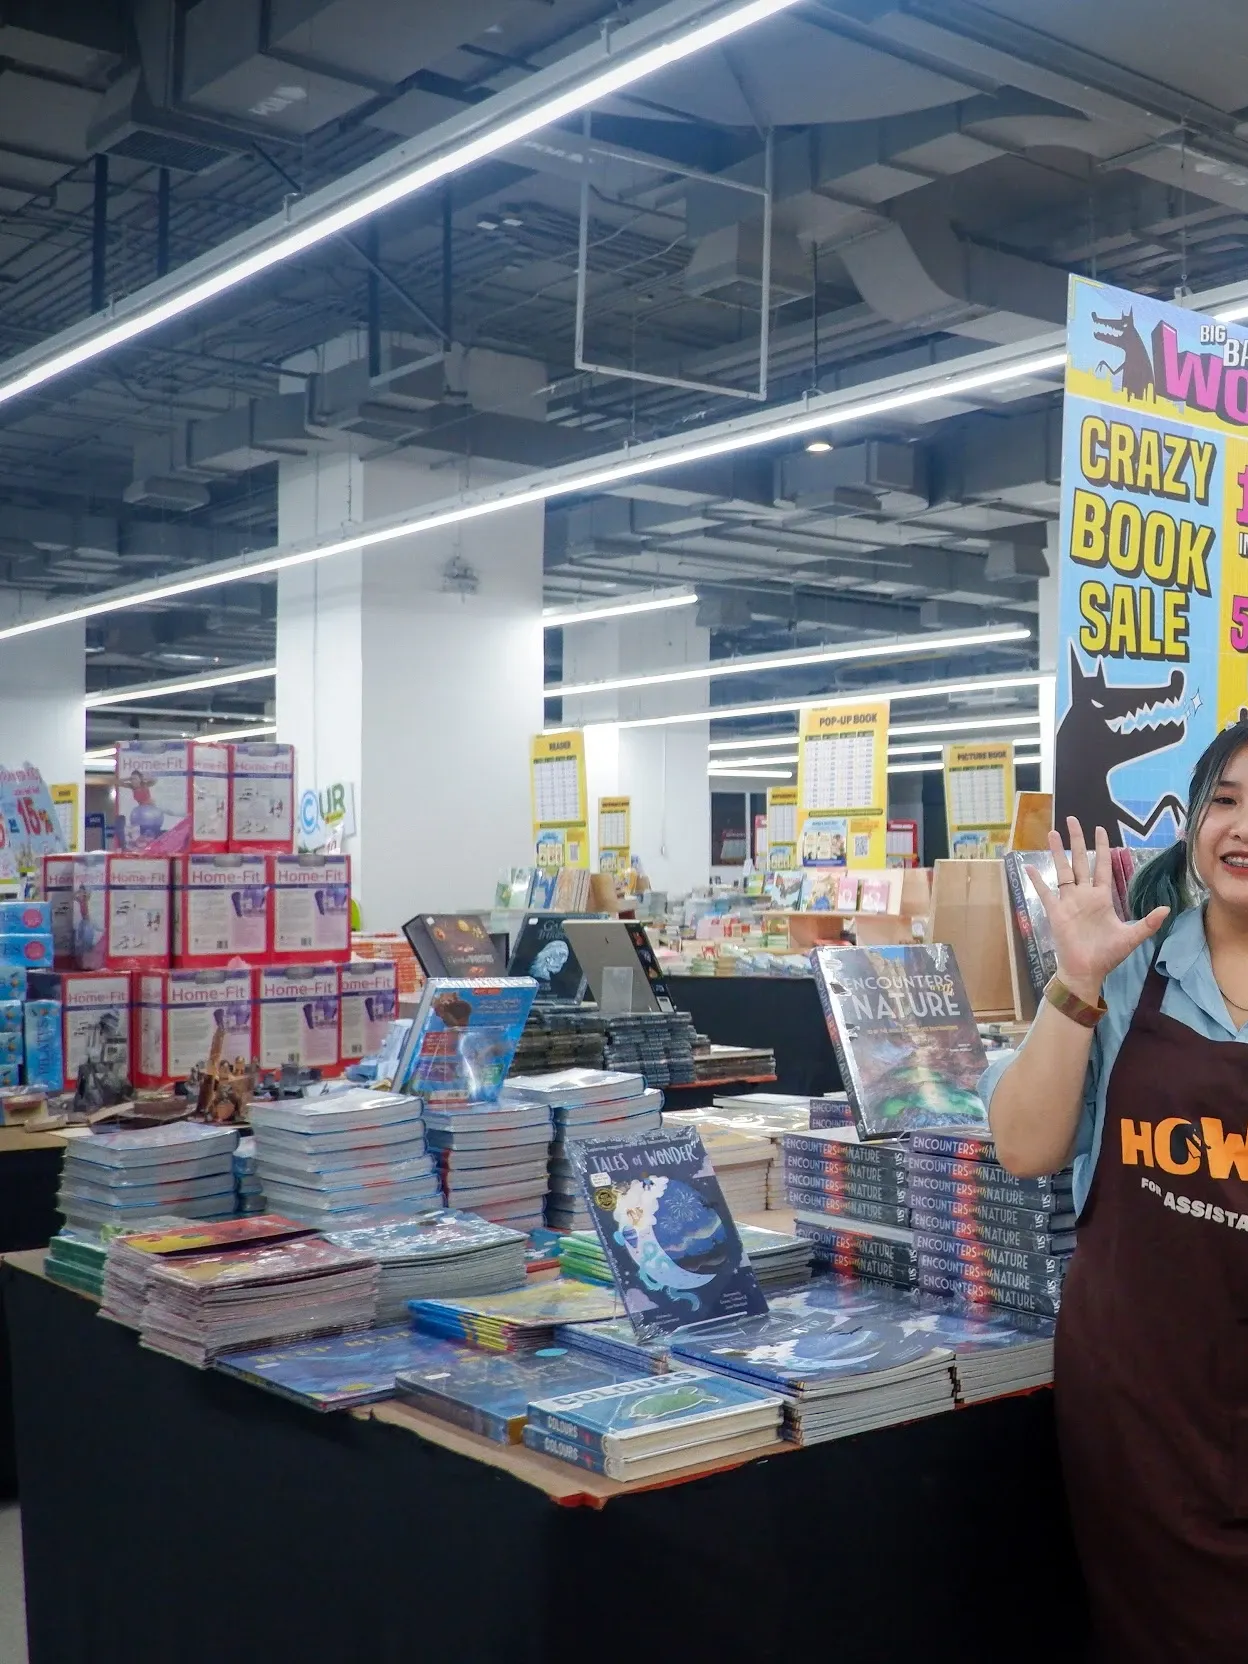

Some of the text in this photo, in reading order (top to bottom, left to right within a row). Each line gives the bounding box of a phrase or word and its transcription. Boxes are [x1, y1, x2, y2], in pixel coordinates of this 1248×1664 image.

[1200, 325, 1227, 344] BIG
[1080, 415, 1217, 506] CRAZY
[1070, 489, 1216, 597] BOOK
[1079, 580, 1190, 662] SALE
[853, 713, 877, 725] BOOK
[122, 756, 183, 771] Home-Fit
[111, 872, 165, 884] Home-Fit
[192, 870, 260, 883] Home-Fit
[278, 869, 344, 882] Home-Fit
[1006, 858, 1029, 929] ENCOUNTERS
[1027, 943, 1045, 989] NATURE
[172, 987, 245, 1001] Home-Fit
[264, 983, 334, 997] Home-Fit
[342, 977, 392, 990] ome-Fit
[843, 975, 953, 990] ENCOUNTERS
[852, 992, 960, 1020] NATURE
[590, 1152, 630, 1173] TALES
[644, 1143, 699, 1167] WONDER
[786, 1138, 837, 1155] ENCOUNTERS
[849, 1147, 880, 1164] NATURE
[913, 1136, 974, 1156] ENCOUNTERS
[788, 1156, 839, 1174] ENCOUNTERS
[850, 1164, 882, 1181] NATURE
[908, 1156, 969, 1177] ENCOUNTERS
[981, 1166, 1020, 1186] NATURE
[788, 1173, 840, 1192] ENCOUNTERS
[851, 1183, 882, 1200] NATURE
[913, 1176, 973, 1196] ENCOUNTERS
[985, 1187, 1025, 1206] NATURE
[1141, 1177, 1162, 1197] FOR
[789, 1192, 840, 1211] ENCOUNTERS
[851, 1201, 883, 1219] NATURE
[910, 1195, 969, 1216] ENCOUNTERS
[980, 1206, 1018, 1225] NATURE
[915, 1214, 972, 1236] ENCOUNTERS
[984, 1225, 1021, 1246] NATURE
[861, 1240, 895, 1260] NATURE
[917, 1236, 977, 1258] ENCOUNTERS
[990, 1248, 1029, 1270] NATURE
[861, 1258, 894, 1277] NATURE
[921, 1255, 980, 1278] ENCOUNTERS
[993, 1267, 1030, 1290] NATURE
[923, 1274, 984, 1297] ENCOUNTERS
[998, 1288, 1036, 1309] NATURE
[553, 1371, 700, 1406] COLOURS
[548, 1416, 579, 1440] COLOURS
[544, 1437, 579, 1461] COLOURS
